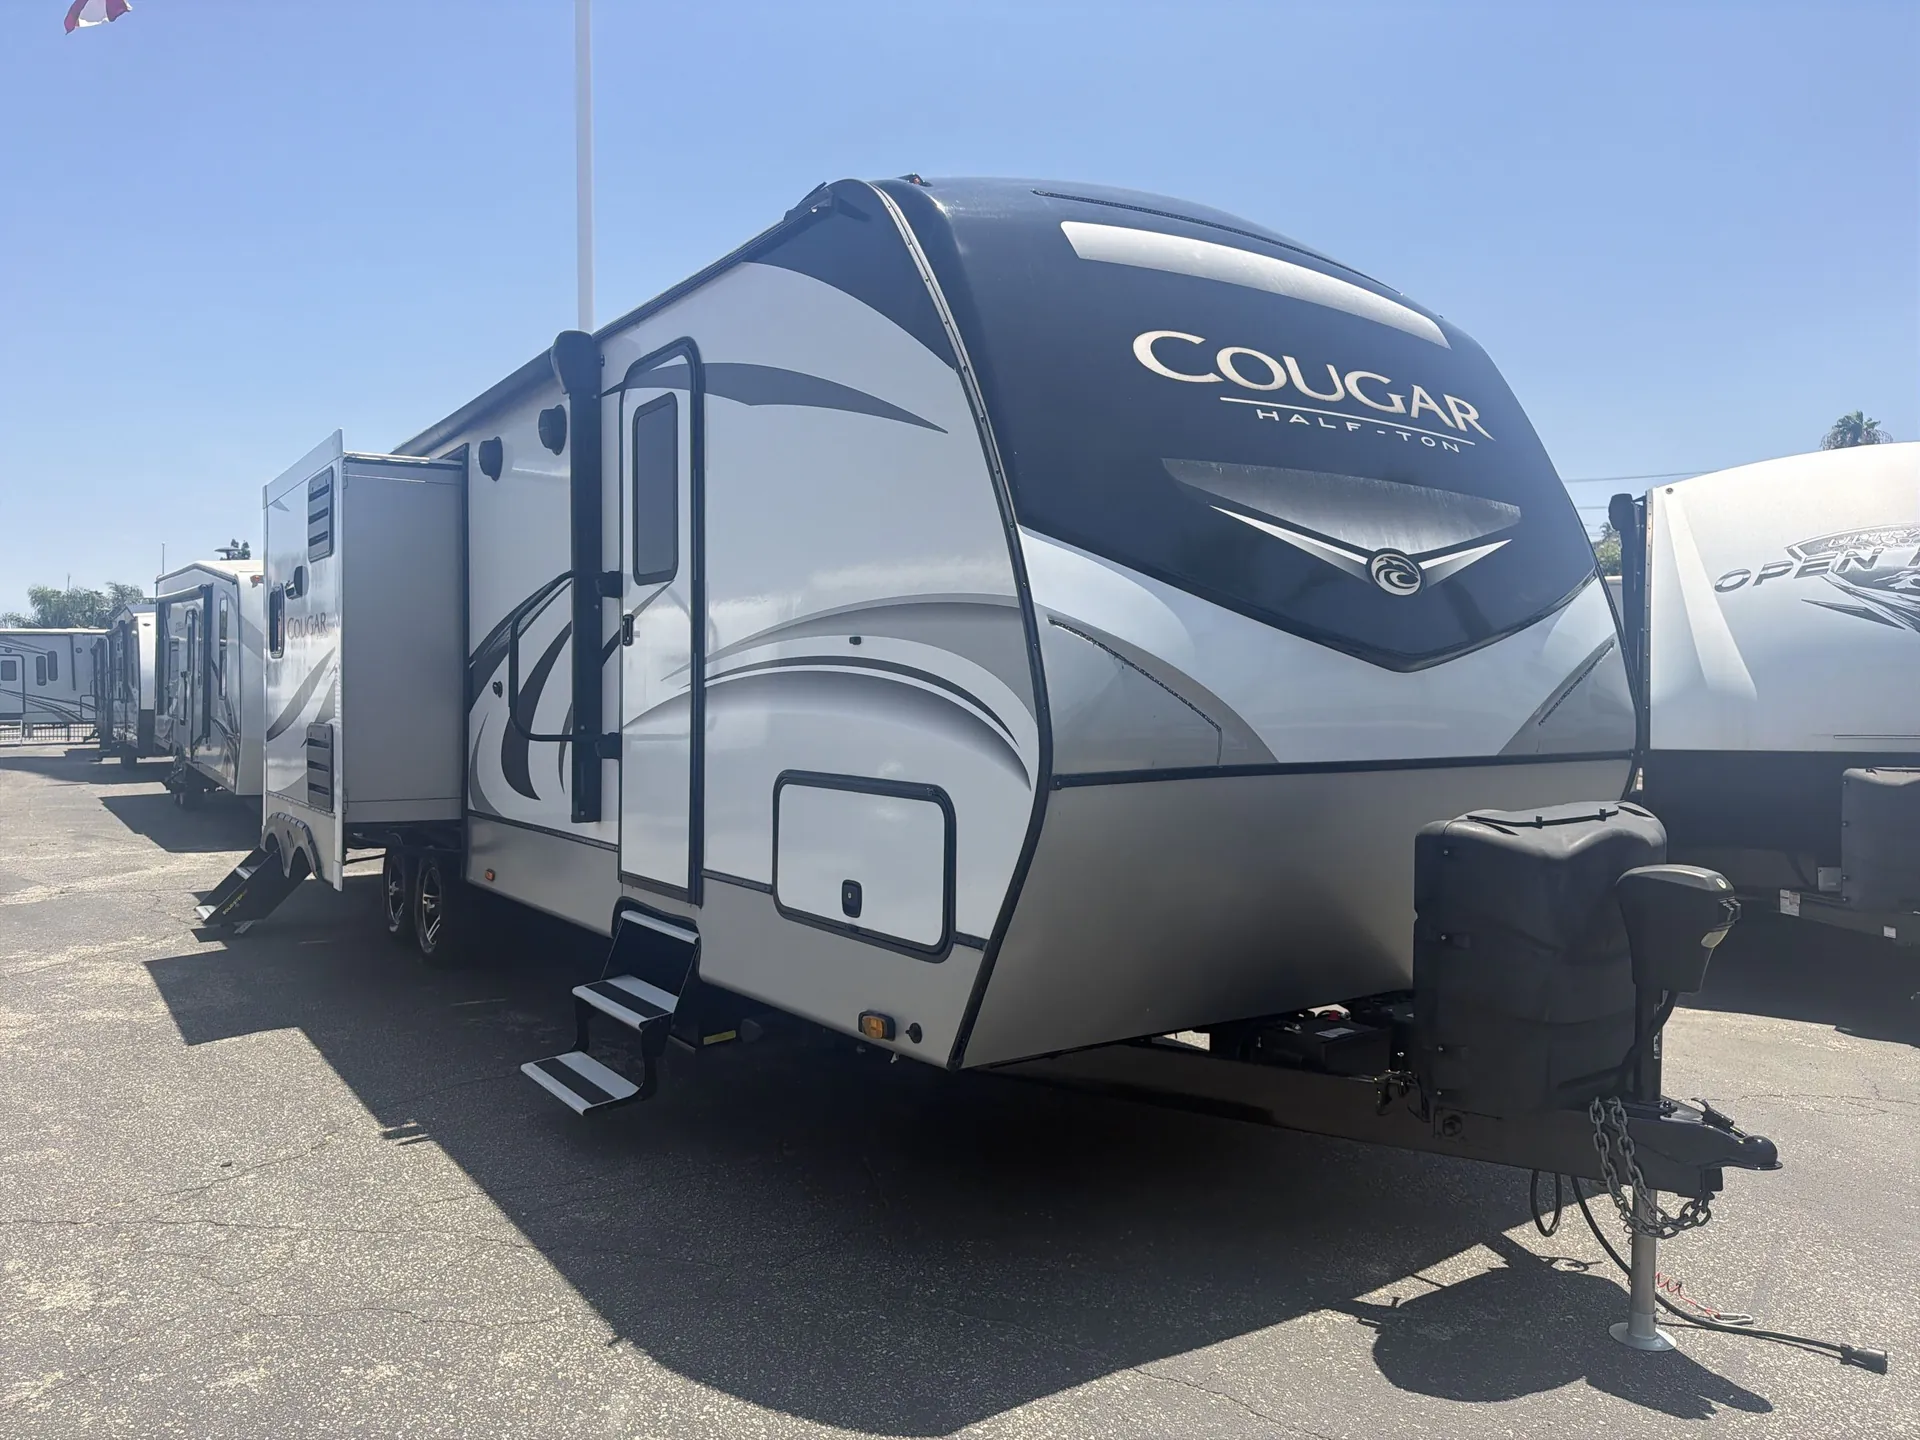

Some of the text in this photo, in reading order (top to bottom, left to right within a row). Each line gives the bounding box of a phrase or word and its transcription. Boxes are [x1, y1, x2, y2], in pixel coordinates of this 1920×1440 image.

[1132, 330, 1496, 441] COUGAR
[1256, 408, 1461, 454] HALF-TON
[1714, 547, 1884, 593] OPEN
[287, 612, 328, 640] COUGAR
